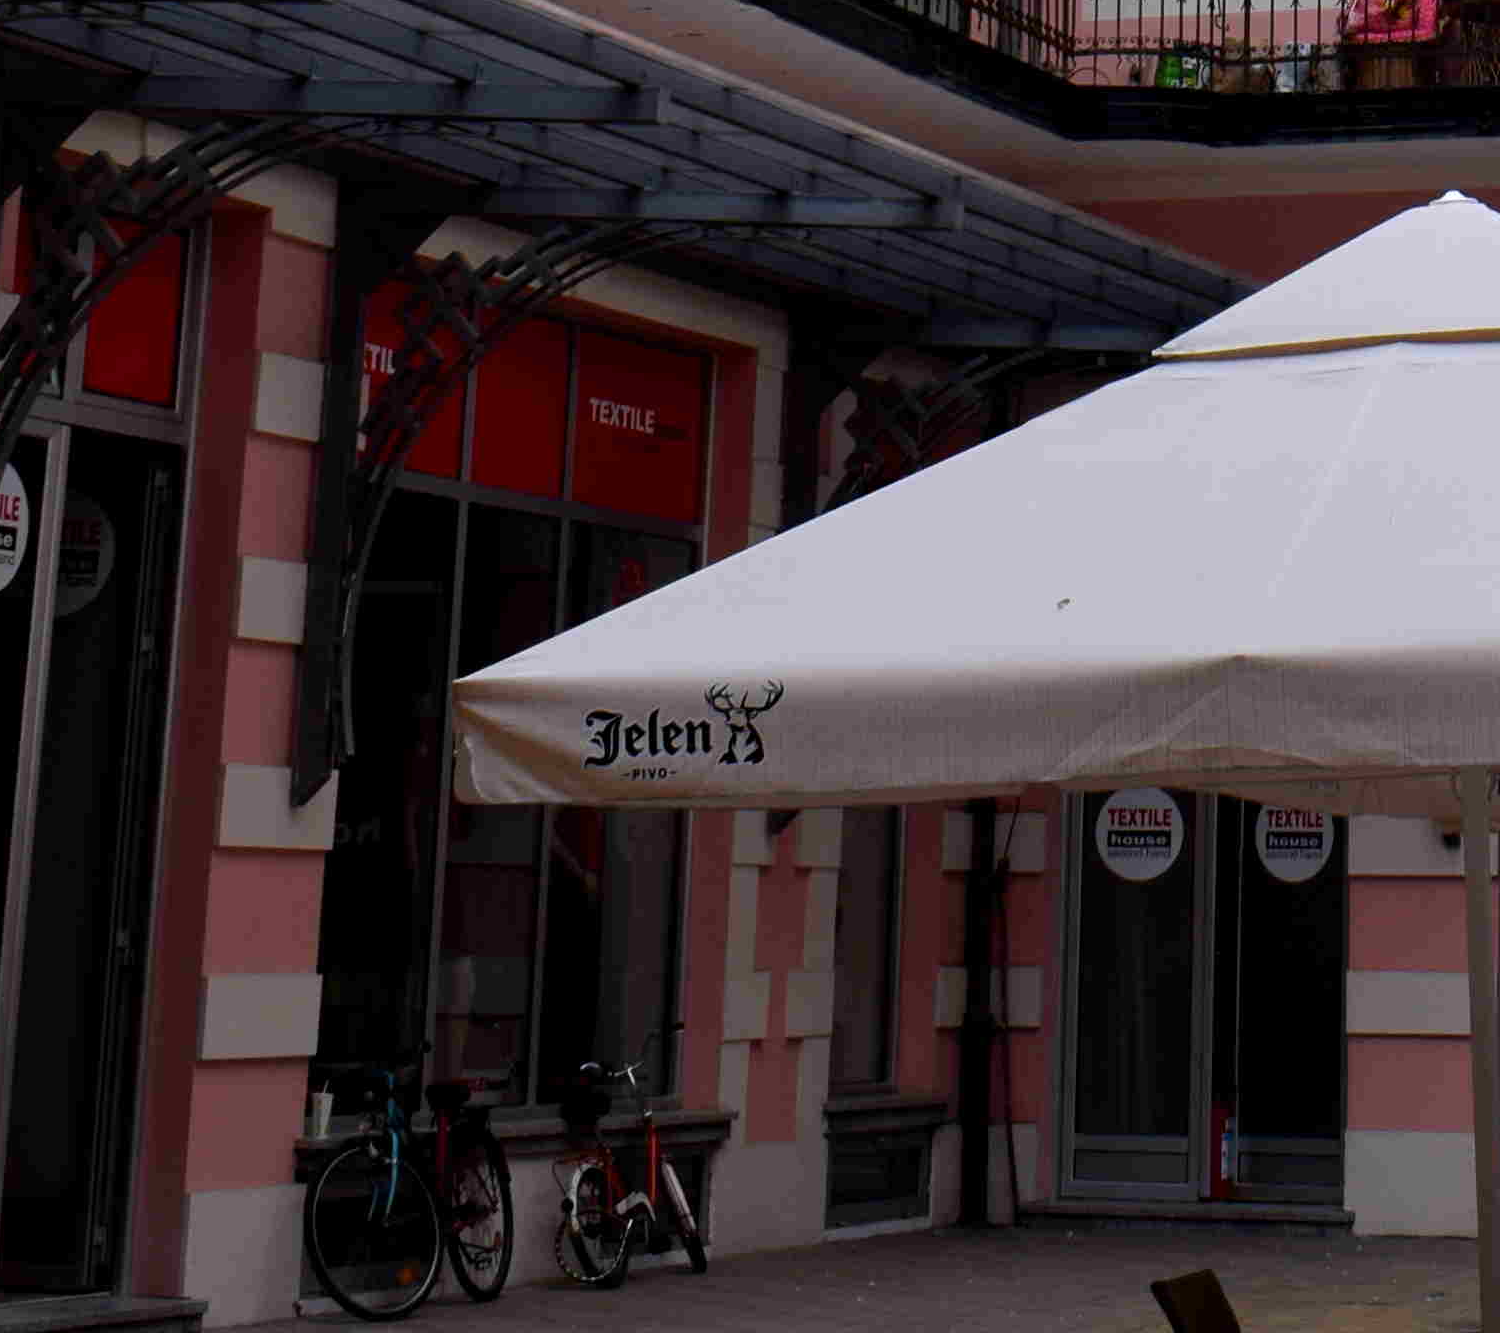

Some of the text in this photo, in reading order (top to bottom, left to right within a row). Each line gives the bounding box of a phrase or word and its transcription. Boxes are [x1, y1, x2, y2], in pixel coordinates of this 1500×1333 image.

[588, 395, 656, 436] TEXTILE
[584, 707, 713, 770] Jelen
[1107, 808, 1172, 827] TEXTILE
[1267, 808, 1323, 829] TEXTILE
